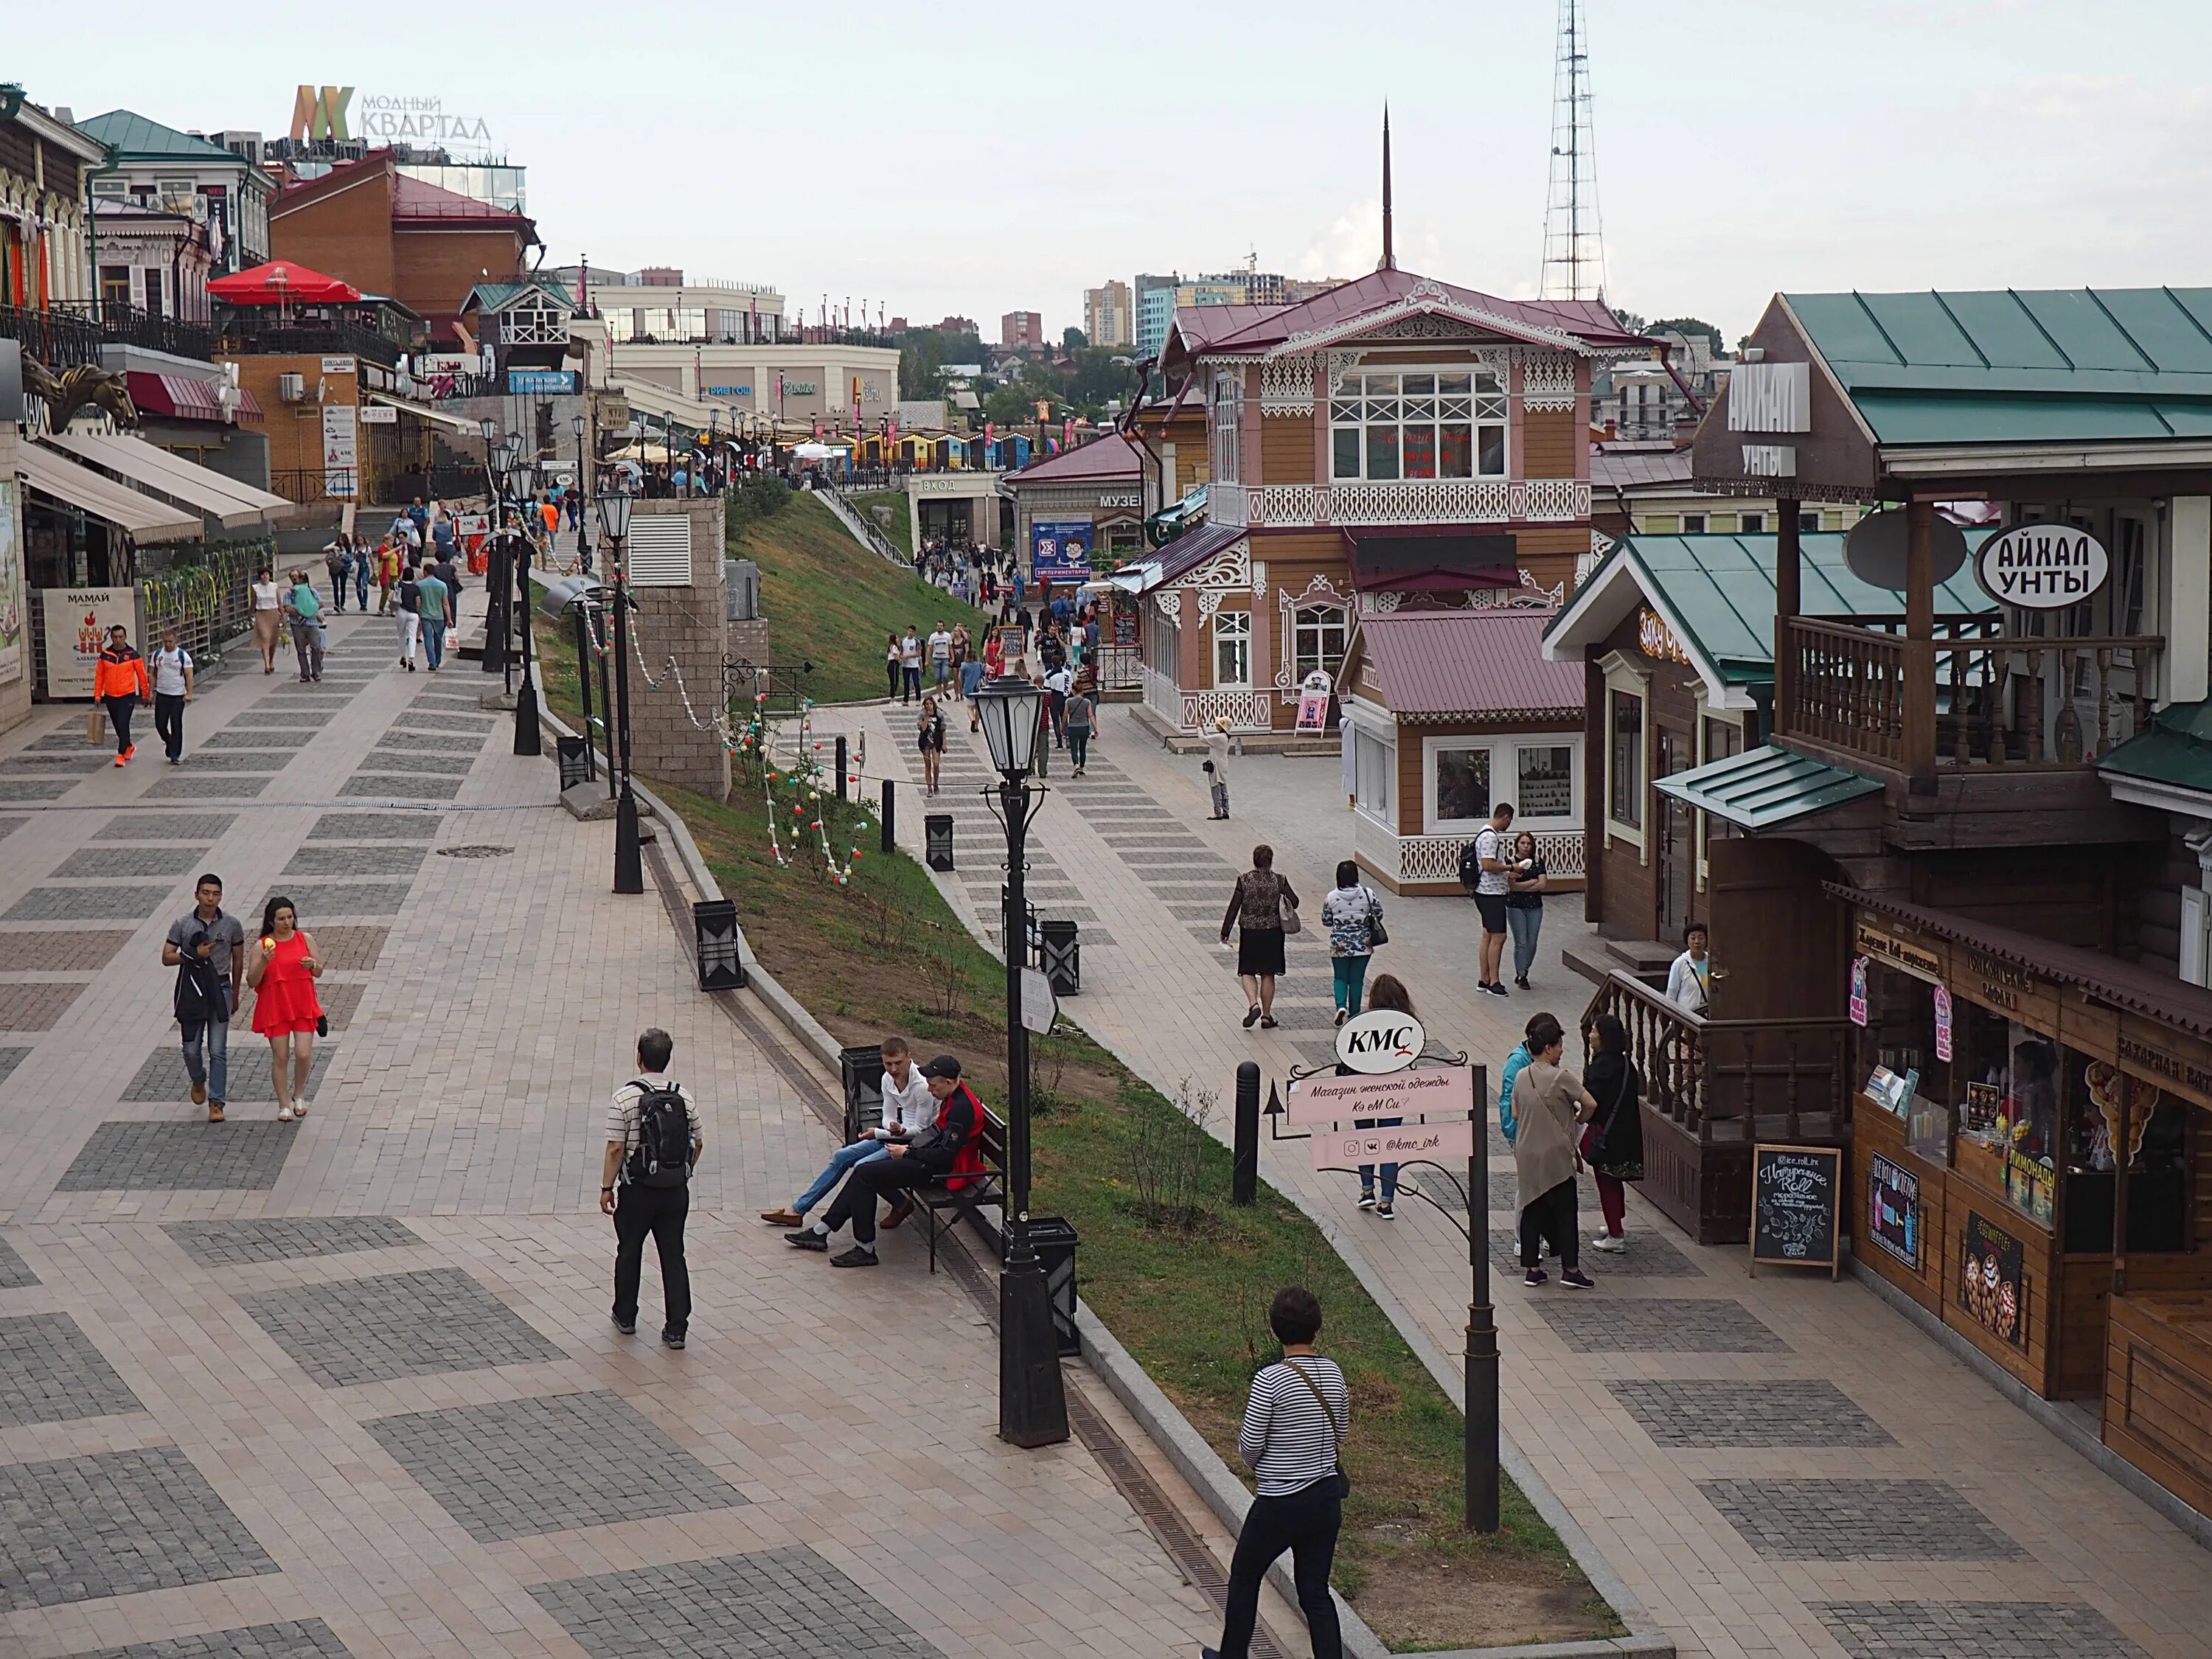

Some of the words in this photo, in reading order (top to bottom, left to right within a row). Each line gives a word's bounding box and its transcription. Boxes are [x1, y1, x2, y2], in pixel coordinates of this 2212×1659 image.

[362, 94, 441, 111] МОДНЫЙ
[362, 111, 492, 140] КВАРТАЛ
[1742, 445, 1782, 477] УНТЫ
[923, 480, 956, 491] ВХОД
[1997, 532, 2090, 568] АЙХАЛ
[1997, 571, 2090, 594] УНТЫ
[67, 592, 110, 605] МАМАЙ
[1310, 1085, 1357, 1101] Магазин
[1360, 1079, 1407, 1093] женской
[1408, 1075, 1450, 1091] одежды
[1352, 1101, 1366, 1113] Кэ
[1385, 1099, 1401, 1110] Си
[1385, 1134, 1440, 1151] @kmc_irk
[2008, 1149, 2056, 1189] ЛИМОНАДЫ
[1777, 1175, 1813, 1194] Roll
